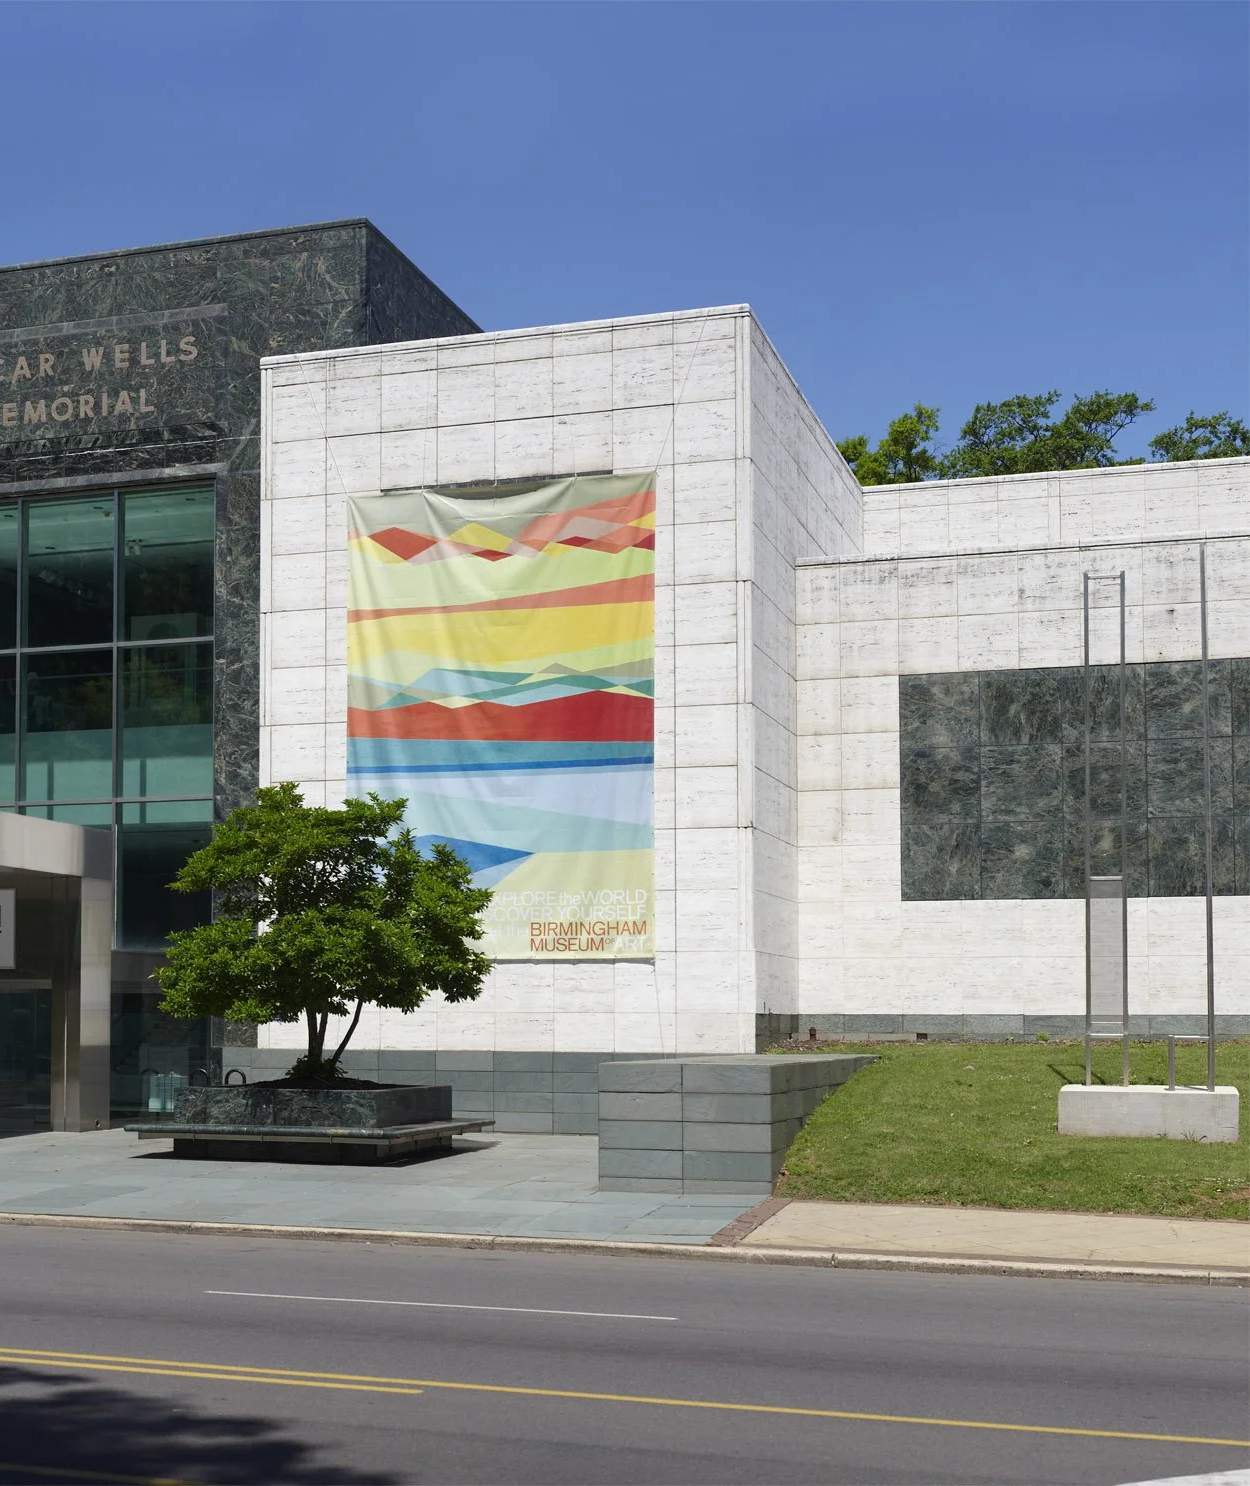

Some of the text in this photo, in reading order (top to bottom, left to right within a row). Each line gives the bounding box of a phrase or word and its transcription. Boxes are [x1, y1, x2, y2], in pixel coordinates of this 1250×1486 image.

[82, 335, 199, 372] WELLS
[493, 889, 647, 907] XPLORE the WORLD
[557, 905, 646, 921] YOURSELF
[530, 921, 647, 937] BIRMINGHAM
[530, 937, 605, 952] MUSEUM
[613, 937, 647, 951] ART
